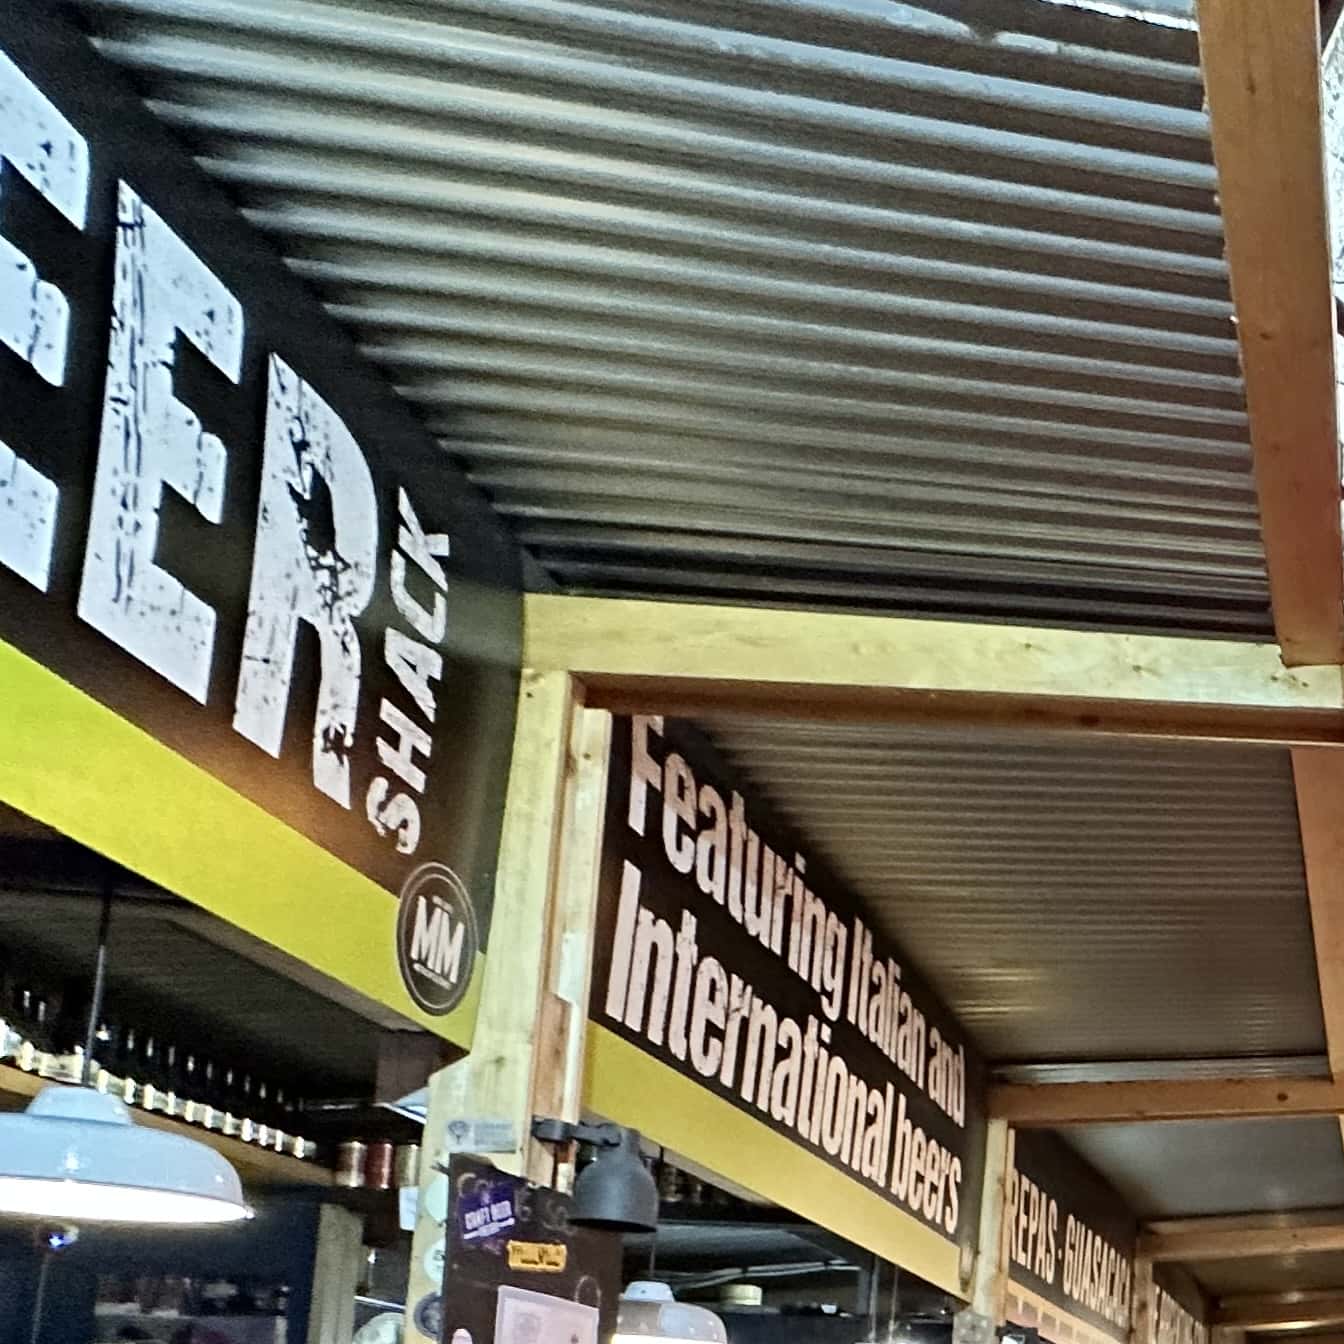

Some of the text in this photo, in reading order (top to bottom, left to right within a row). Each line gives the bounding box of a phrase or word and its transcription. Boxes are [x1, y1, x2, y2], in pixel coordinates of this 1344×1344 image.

[365, 485, 450, 854] SHACK
[410, 895, 465, 984] MM
[605, 859, 962, 1236] International beers
[628, 714, 967, 1128] Featuring Italian and
